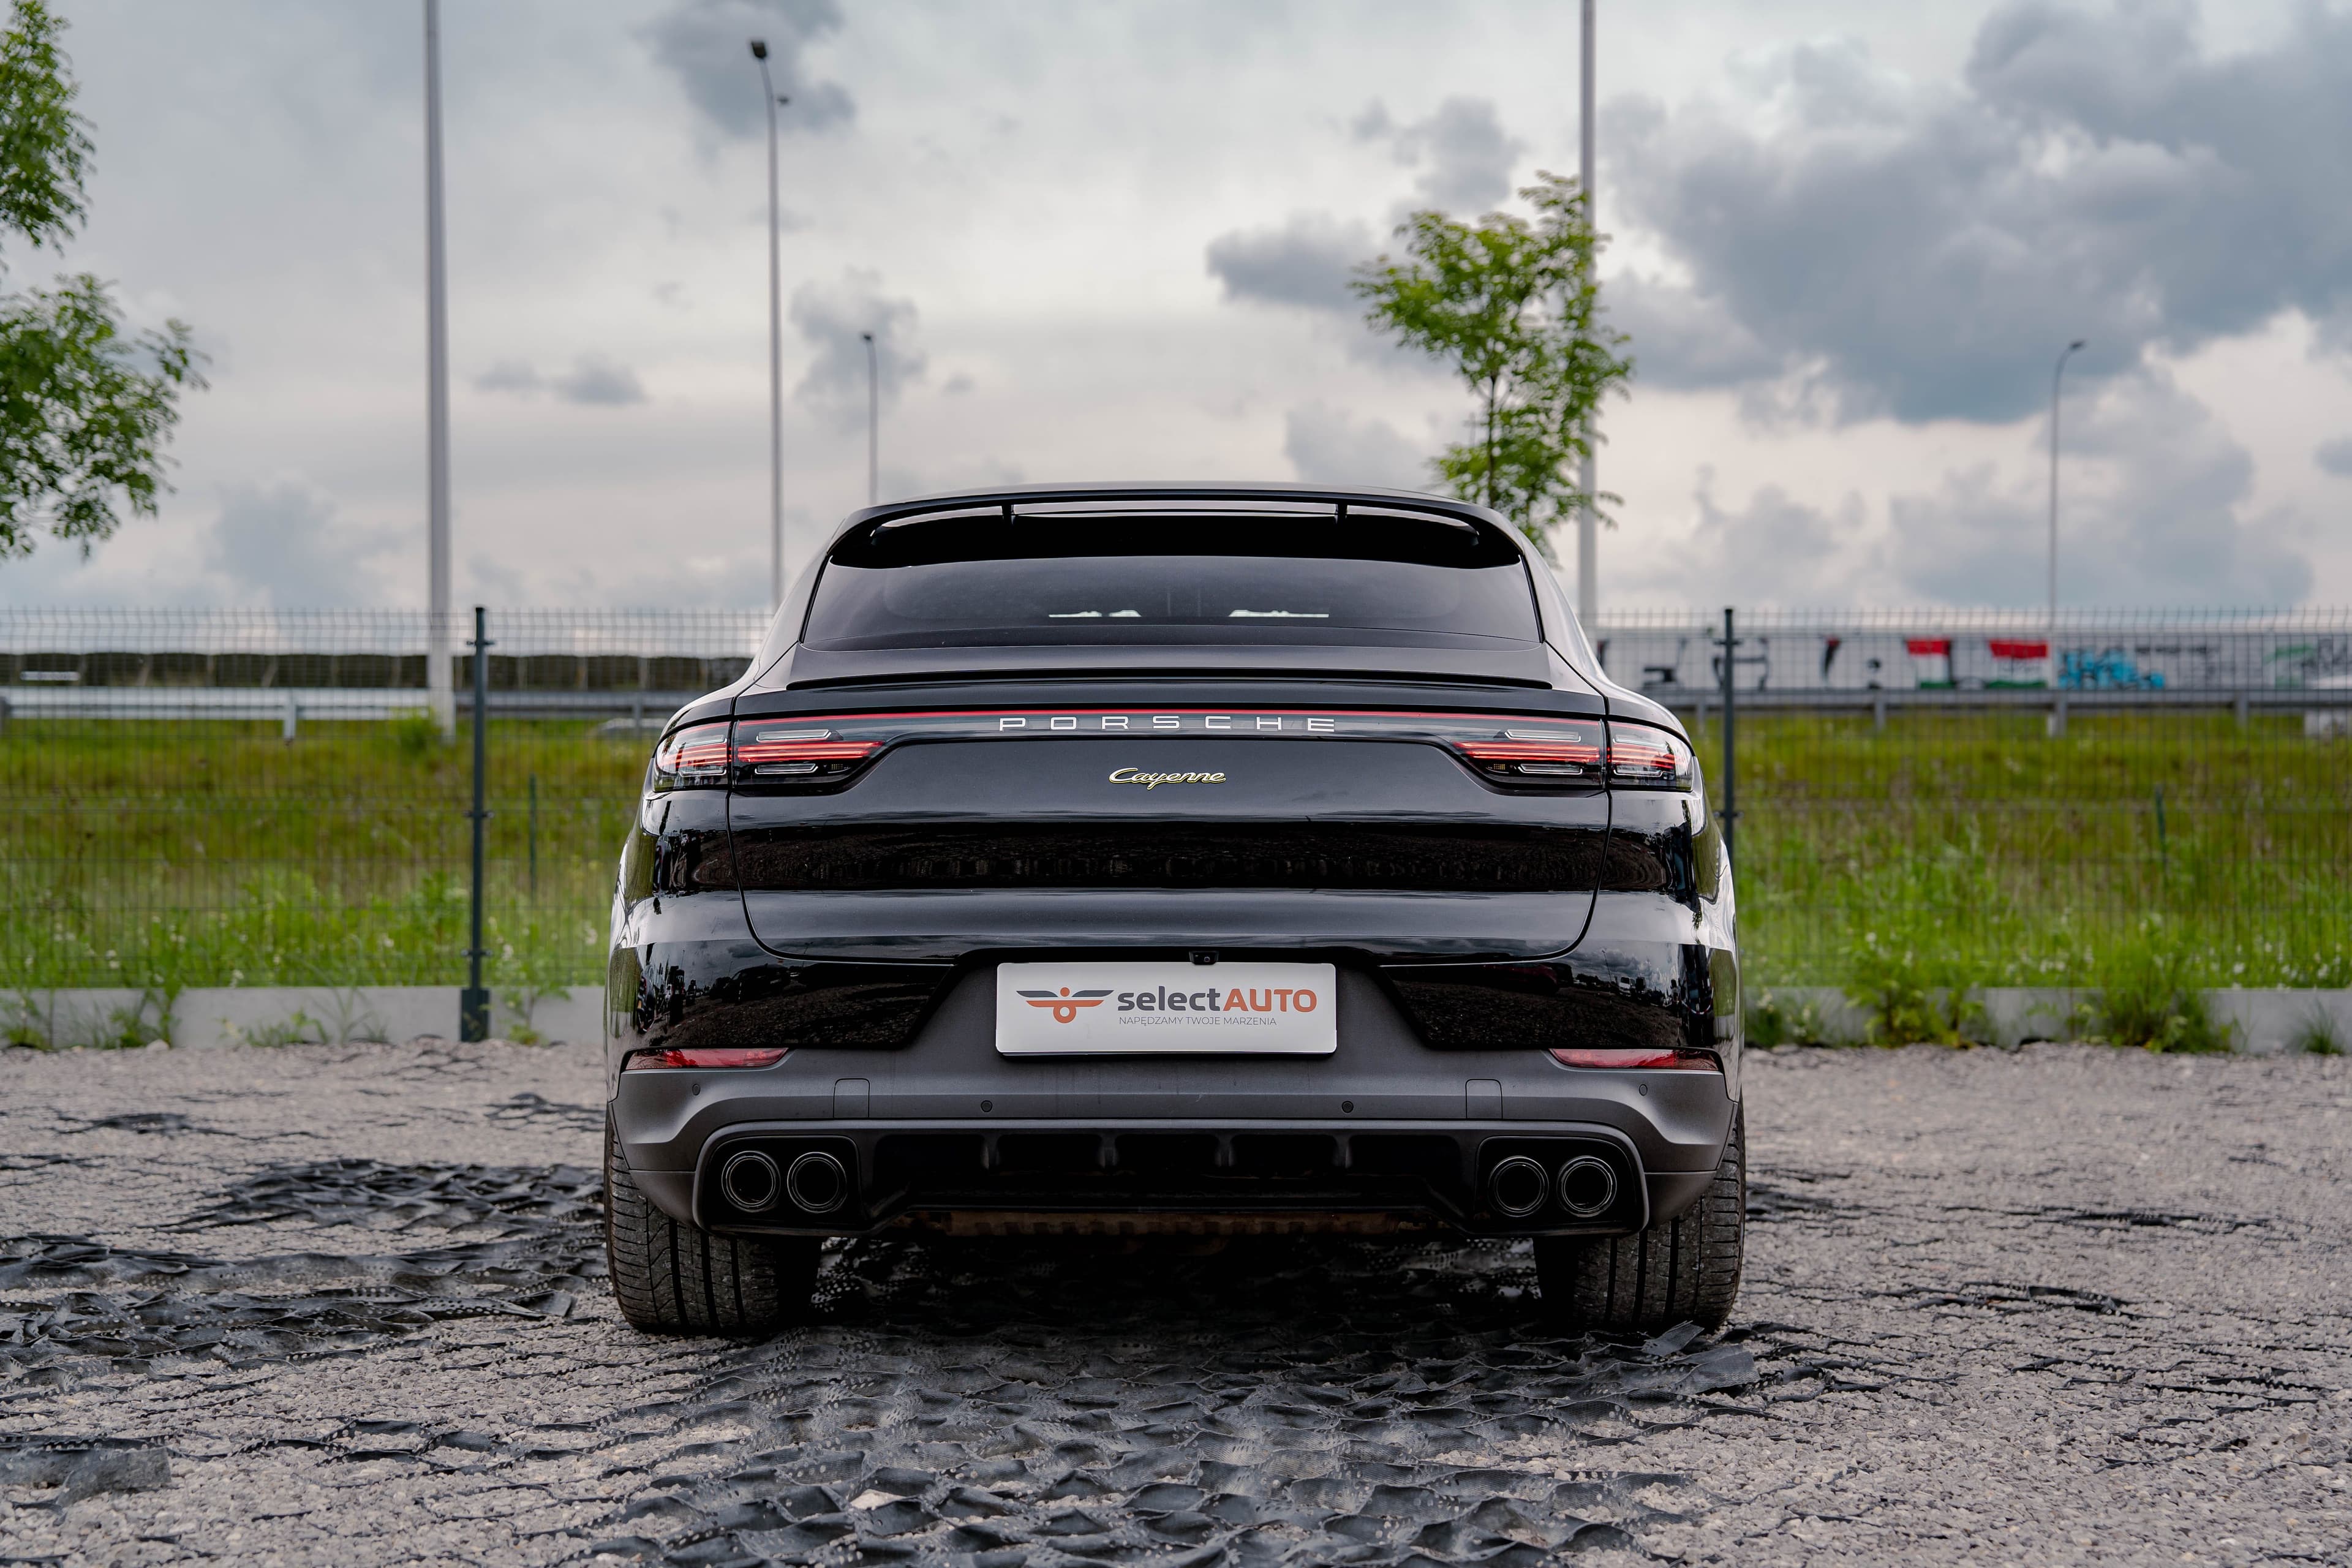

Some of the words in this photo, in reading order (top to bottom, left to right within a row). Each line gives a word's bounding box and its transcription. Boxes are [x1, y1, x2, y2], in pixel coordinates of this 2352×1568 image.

[999, 715, 1335, 732] PORSCHE
[1109, 767, 1226, 790] Cayenne
[1117, 986, 1317, 1012] selectAUTO
[1119, 1017, 1183, 1027] NAPĘDZAMY
[1186, 1017, 1221, 1025] TWOJE
[1223, 1017, 1277, 1026] MARZENIA
